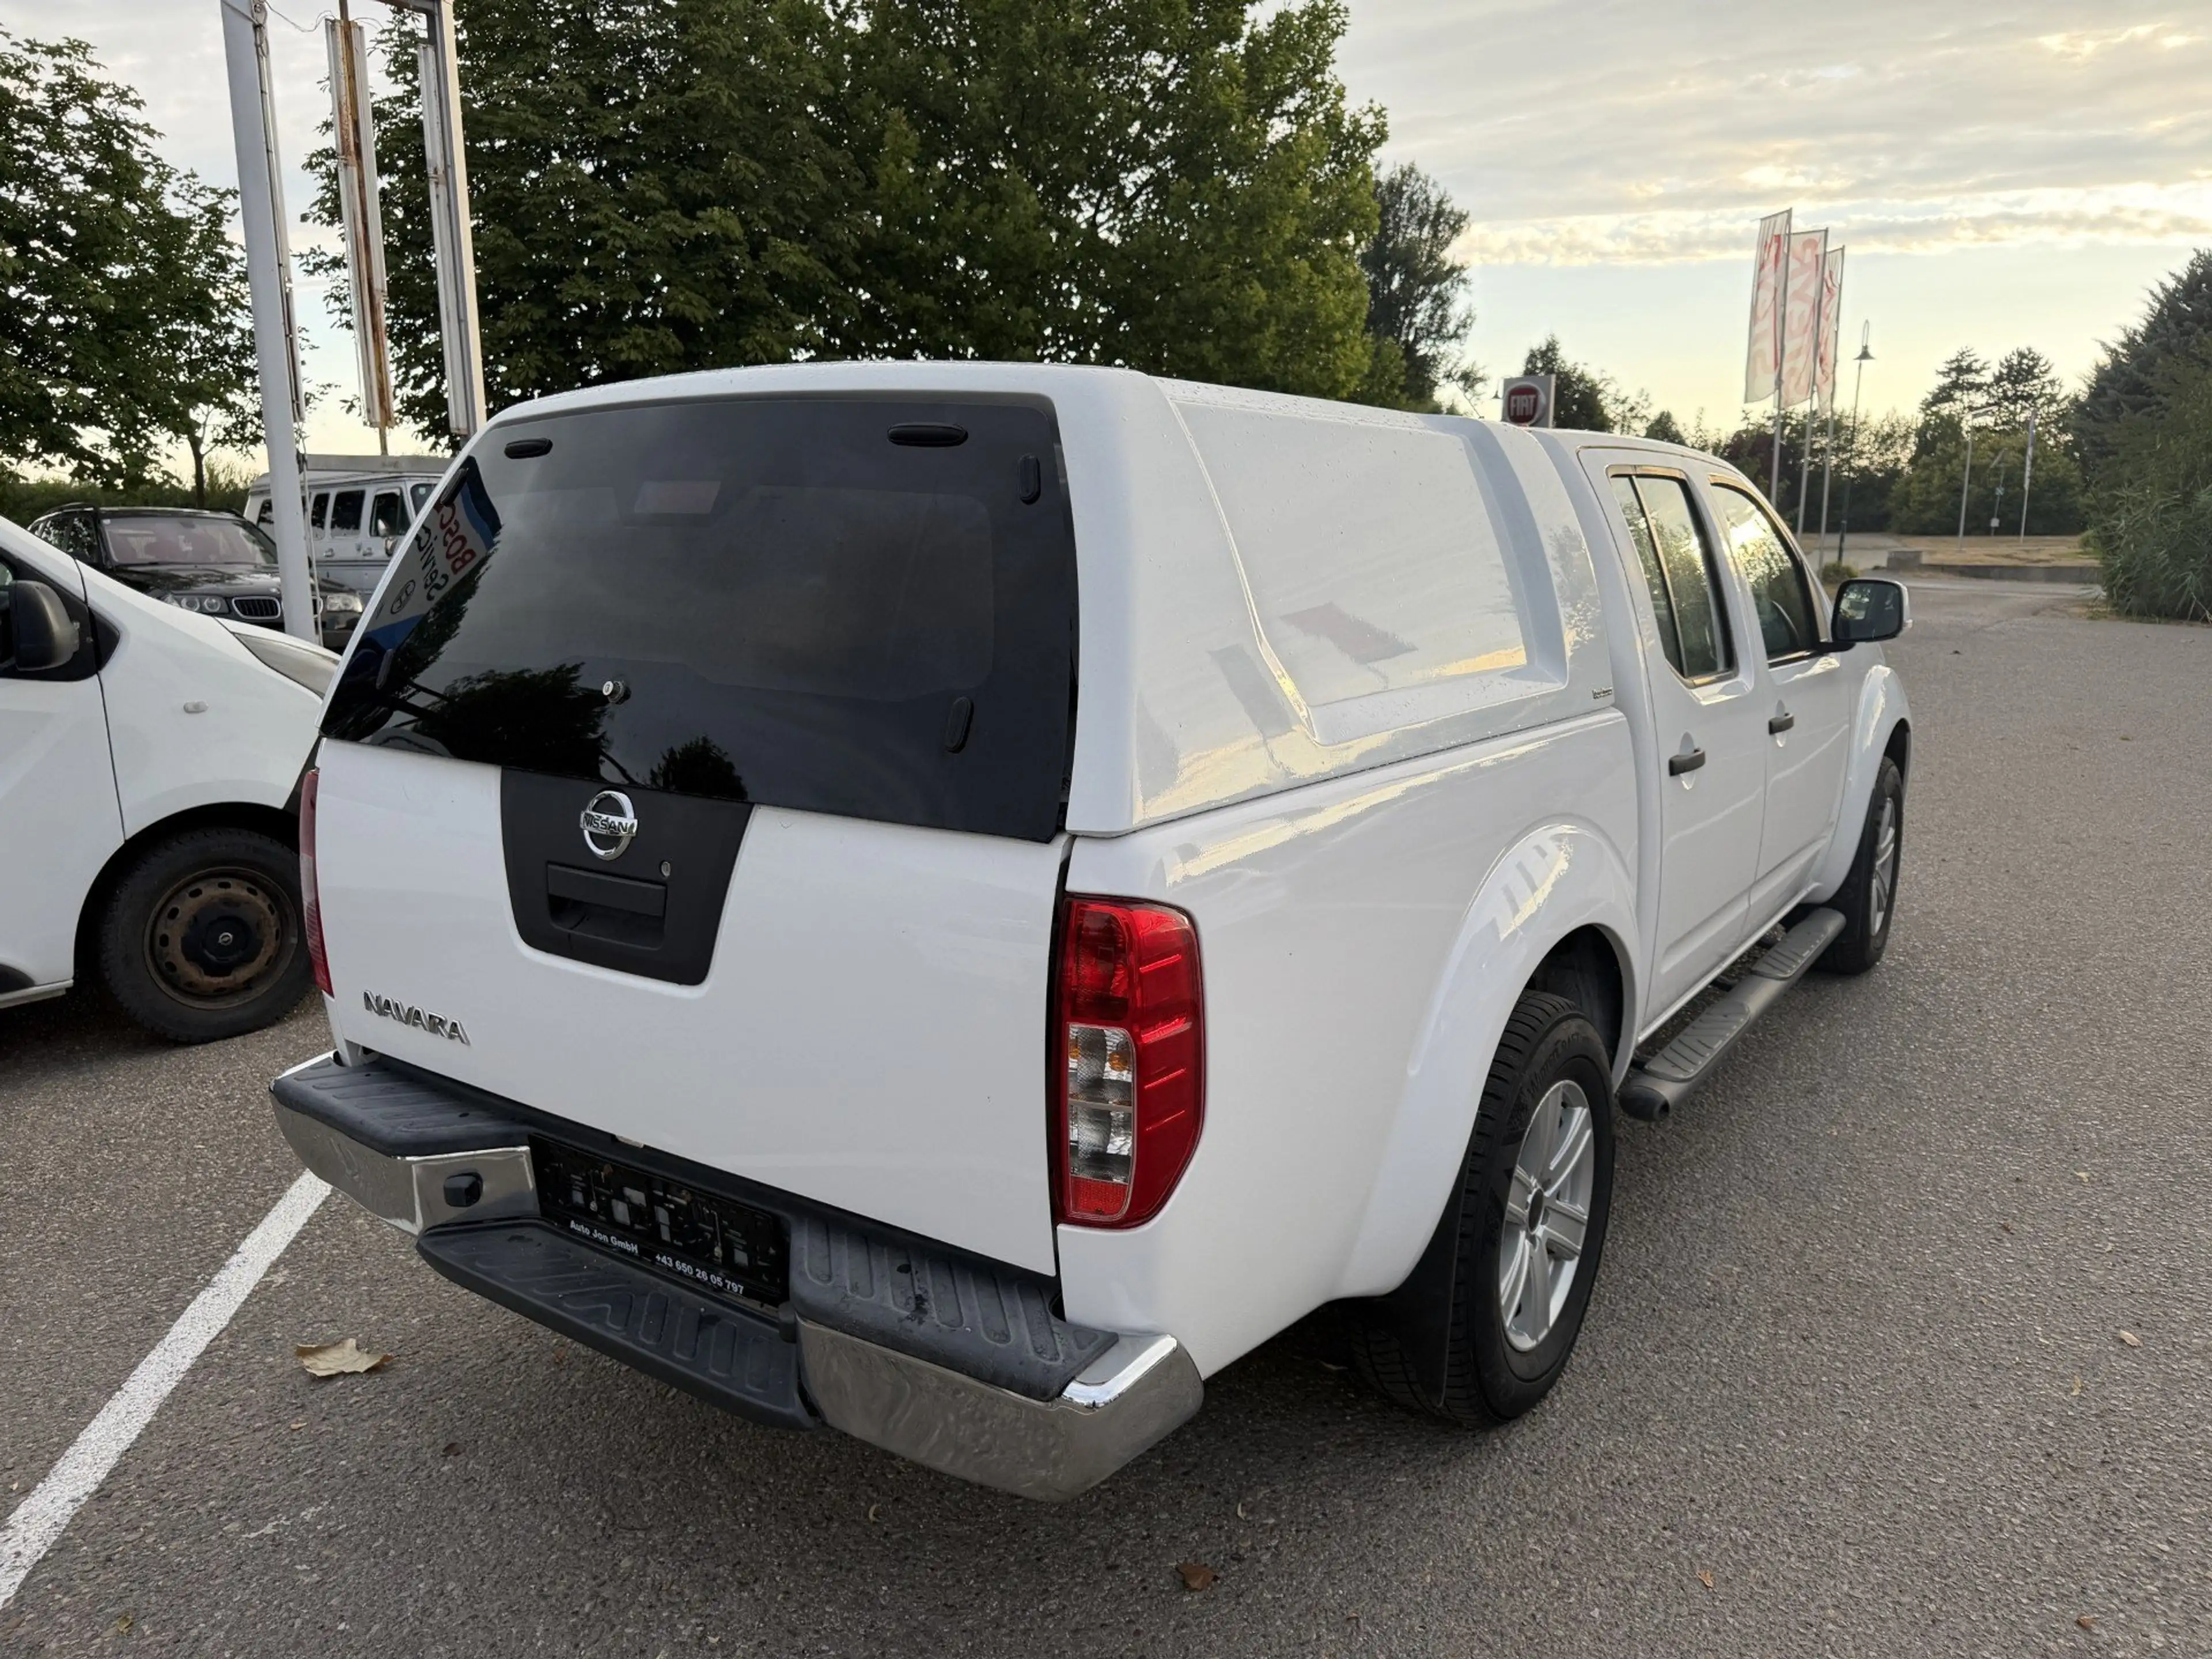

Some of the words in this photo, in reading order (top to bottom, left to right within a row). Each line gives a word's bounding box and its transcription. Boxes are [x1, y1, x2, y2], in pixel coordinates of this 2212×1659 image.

[1510, 395, 1536, 416] FIAT
[583, 812, 628, 833] NISSAN
[363, 989, 471, 1046] NAVARA
[570, 1219, 591, 1236] Auto
[592, 1228, 609, 1244] Jon
[610, 1236, 639, 1255] GmbH
[655, 1253, 673, 1267] +43
[675, 1260, 694, 1275] 650
[695, 1268, 709, 1282] 26
[710, 1274, 724, 1287] 05
[725, 1279, 744, 1294] 797
